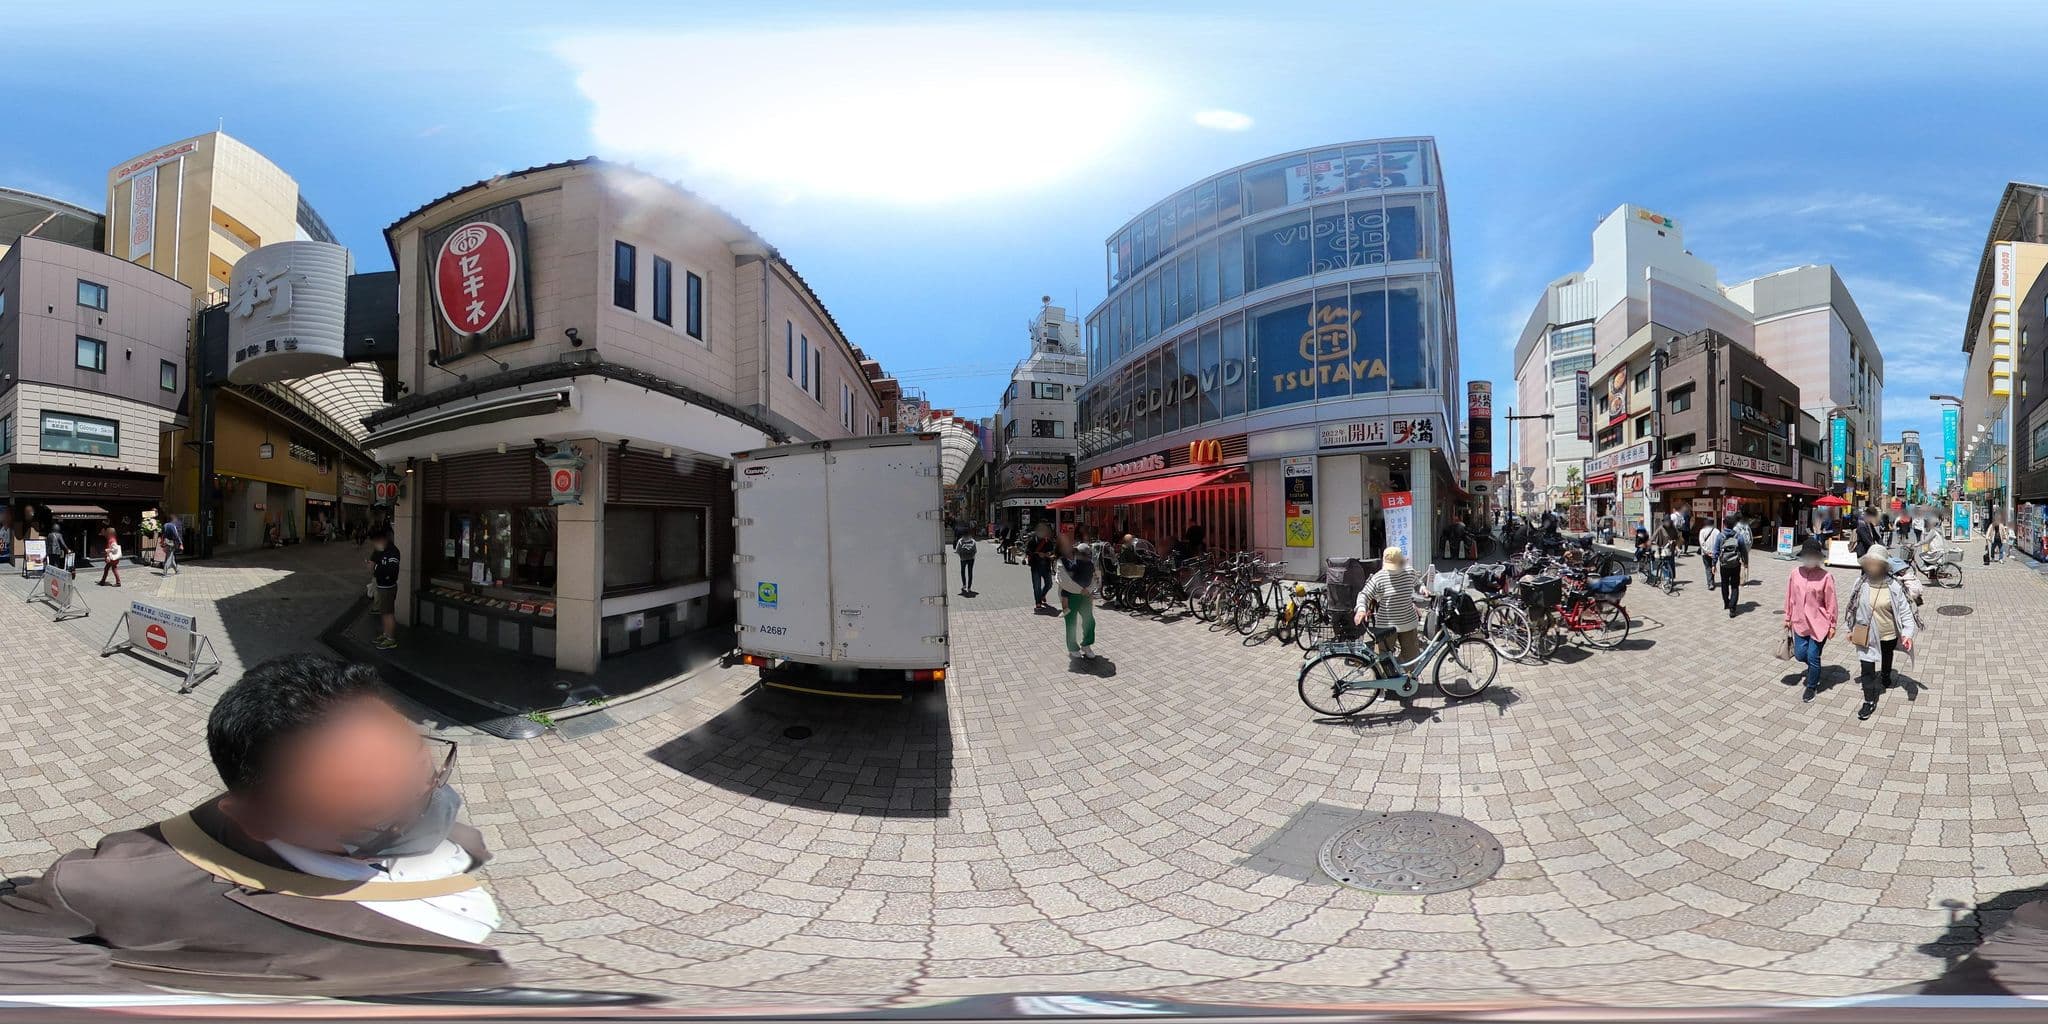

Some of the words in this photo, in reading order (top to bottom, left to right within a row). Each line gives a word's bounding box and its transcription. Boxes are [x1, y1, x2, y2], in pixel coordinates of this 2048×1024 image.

[1273, 212, 1390, 246] VIDEO
[1328, 229, 1391, 251] CD
[459, 254, 486, 326] セキネ
[1272, 358, 1387, 393] TSUTAYA
[1348, 421, 1384, 442] 開店
[1102, 454, 1166, 480] McDonald's
[1723, 454, 1749, 468] とんかつ
[1388, 496, 1405, 506] 日本
[760, 624, 787, 635] A2687
